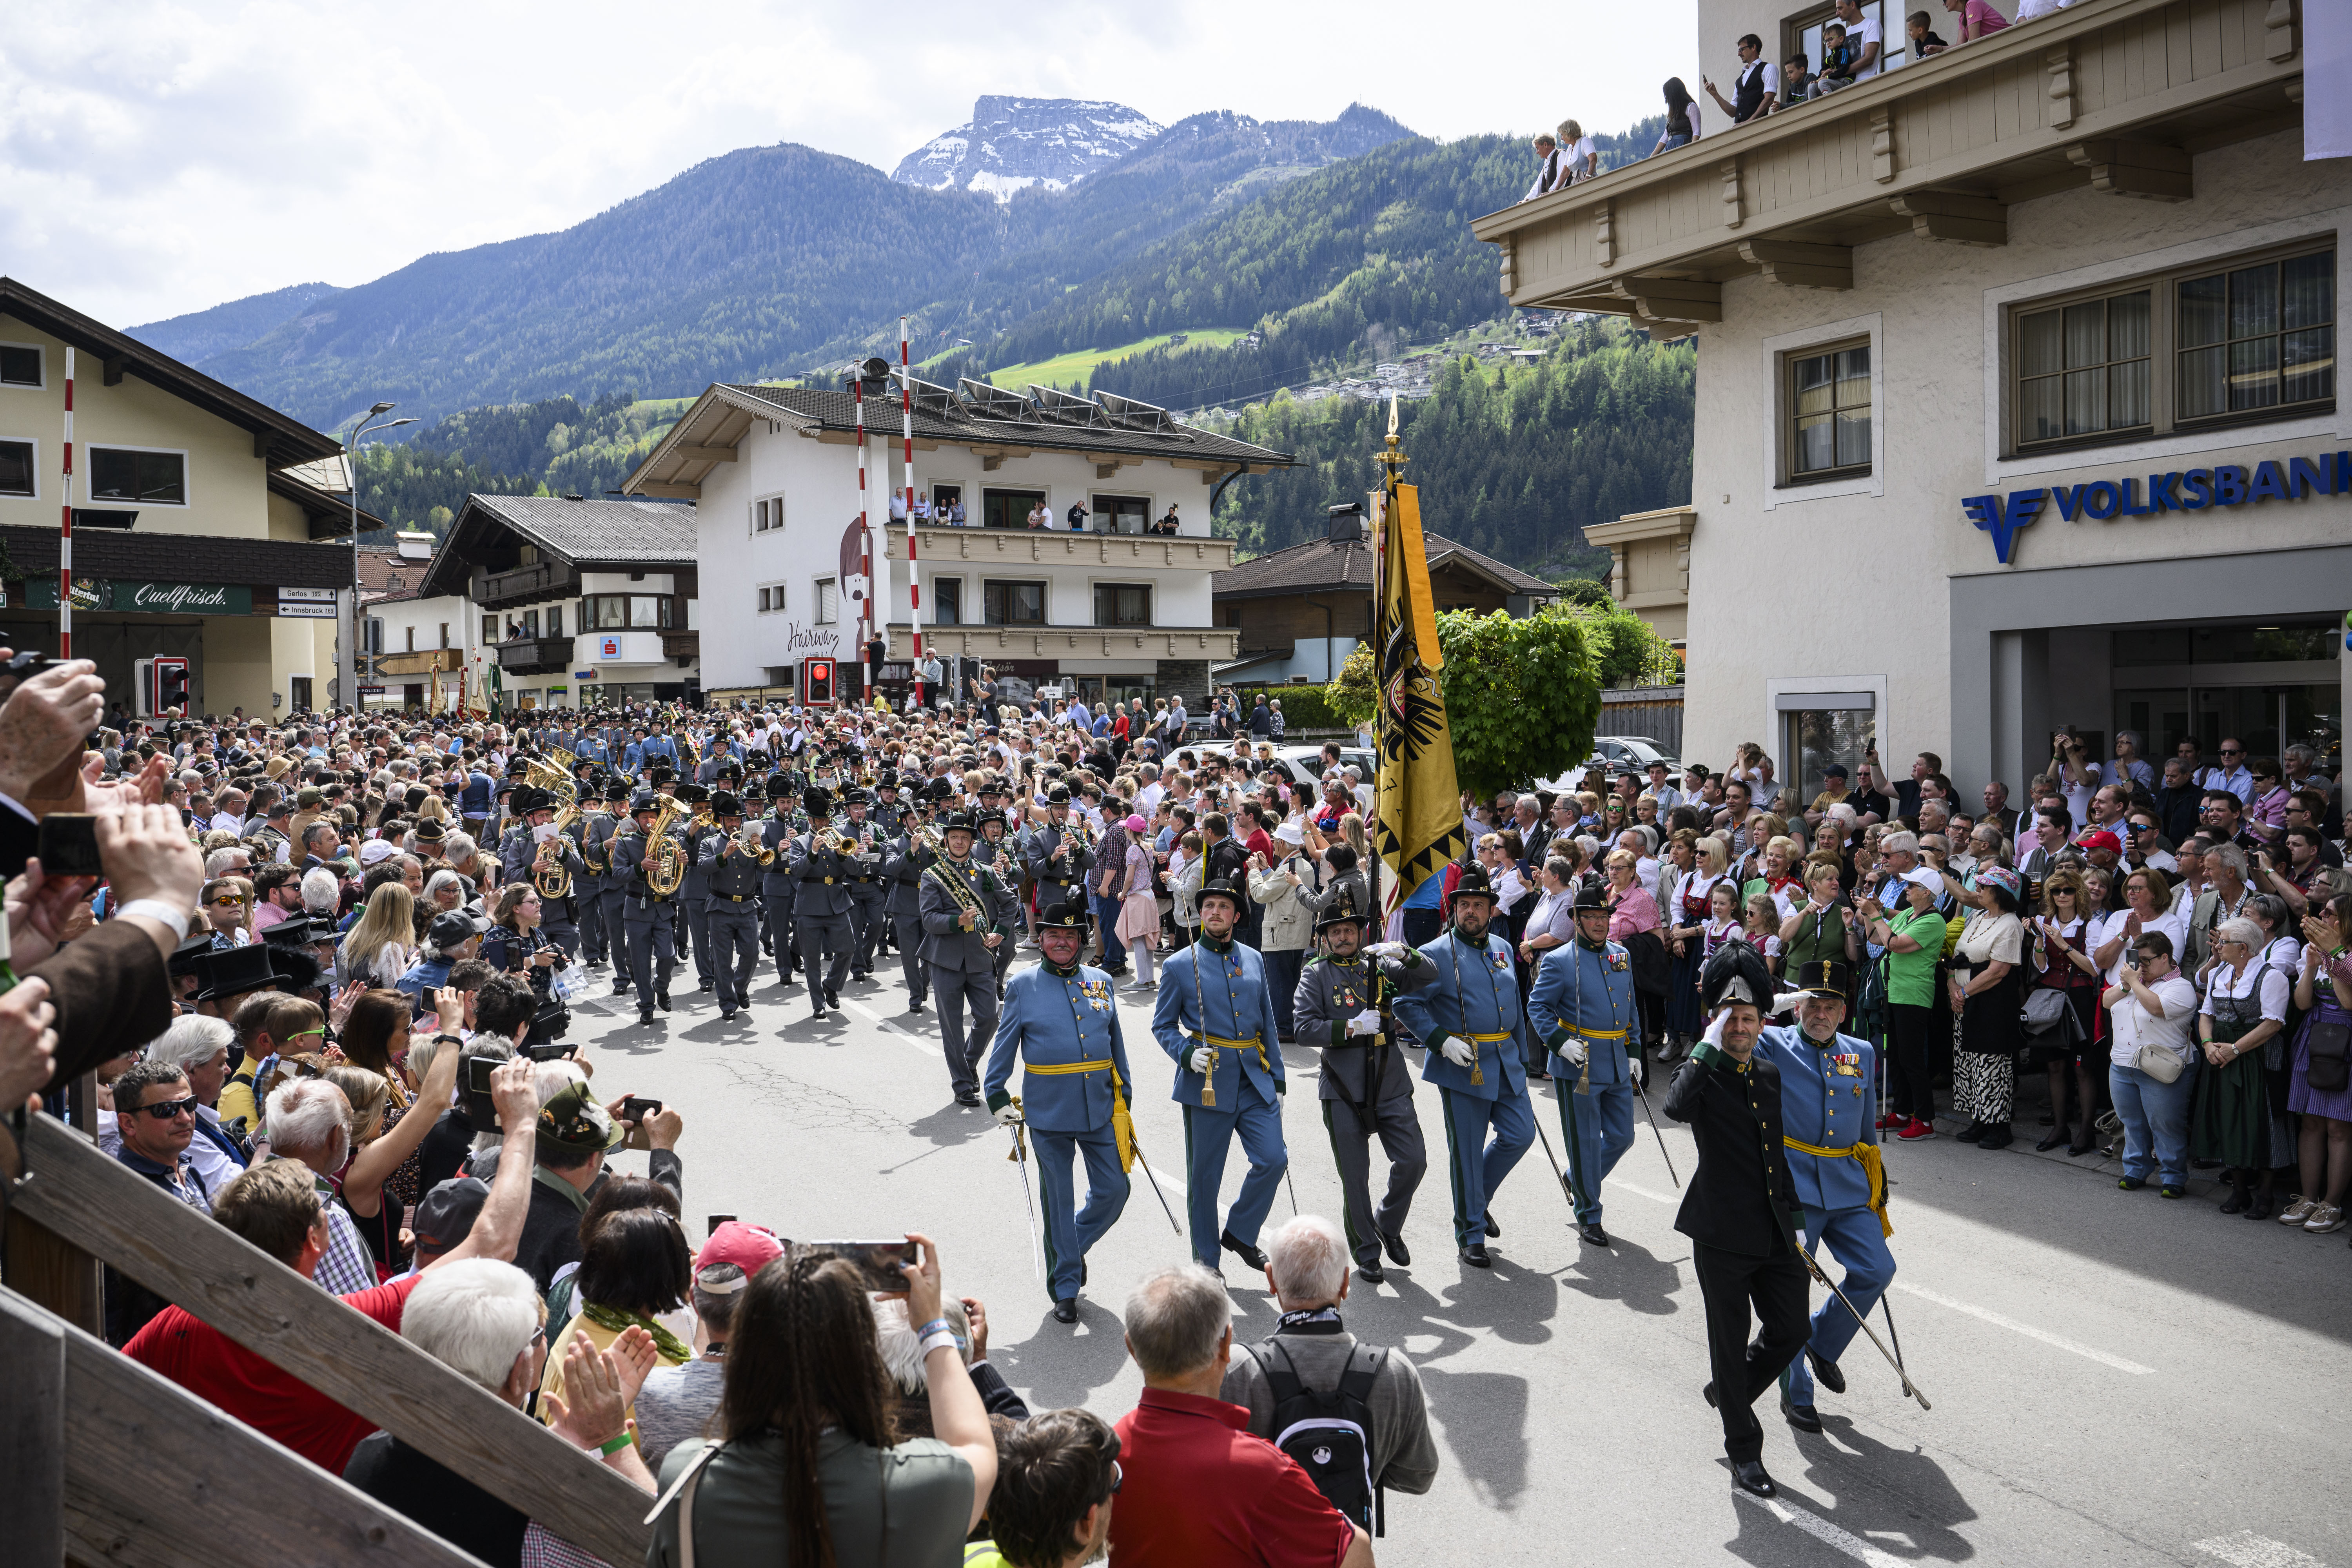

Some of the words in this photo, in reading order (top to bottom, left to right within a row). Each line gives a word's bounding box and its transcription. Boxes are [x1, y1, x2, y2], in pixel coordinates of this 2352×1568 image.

[135, 583, 226, 611] Quellfrisch.
[788, 620, 839, 657] Hairway
[1285, 1311, 1313, 1325] Zillerta
